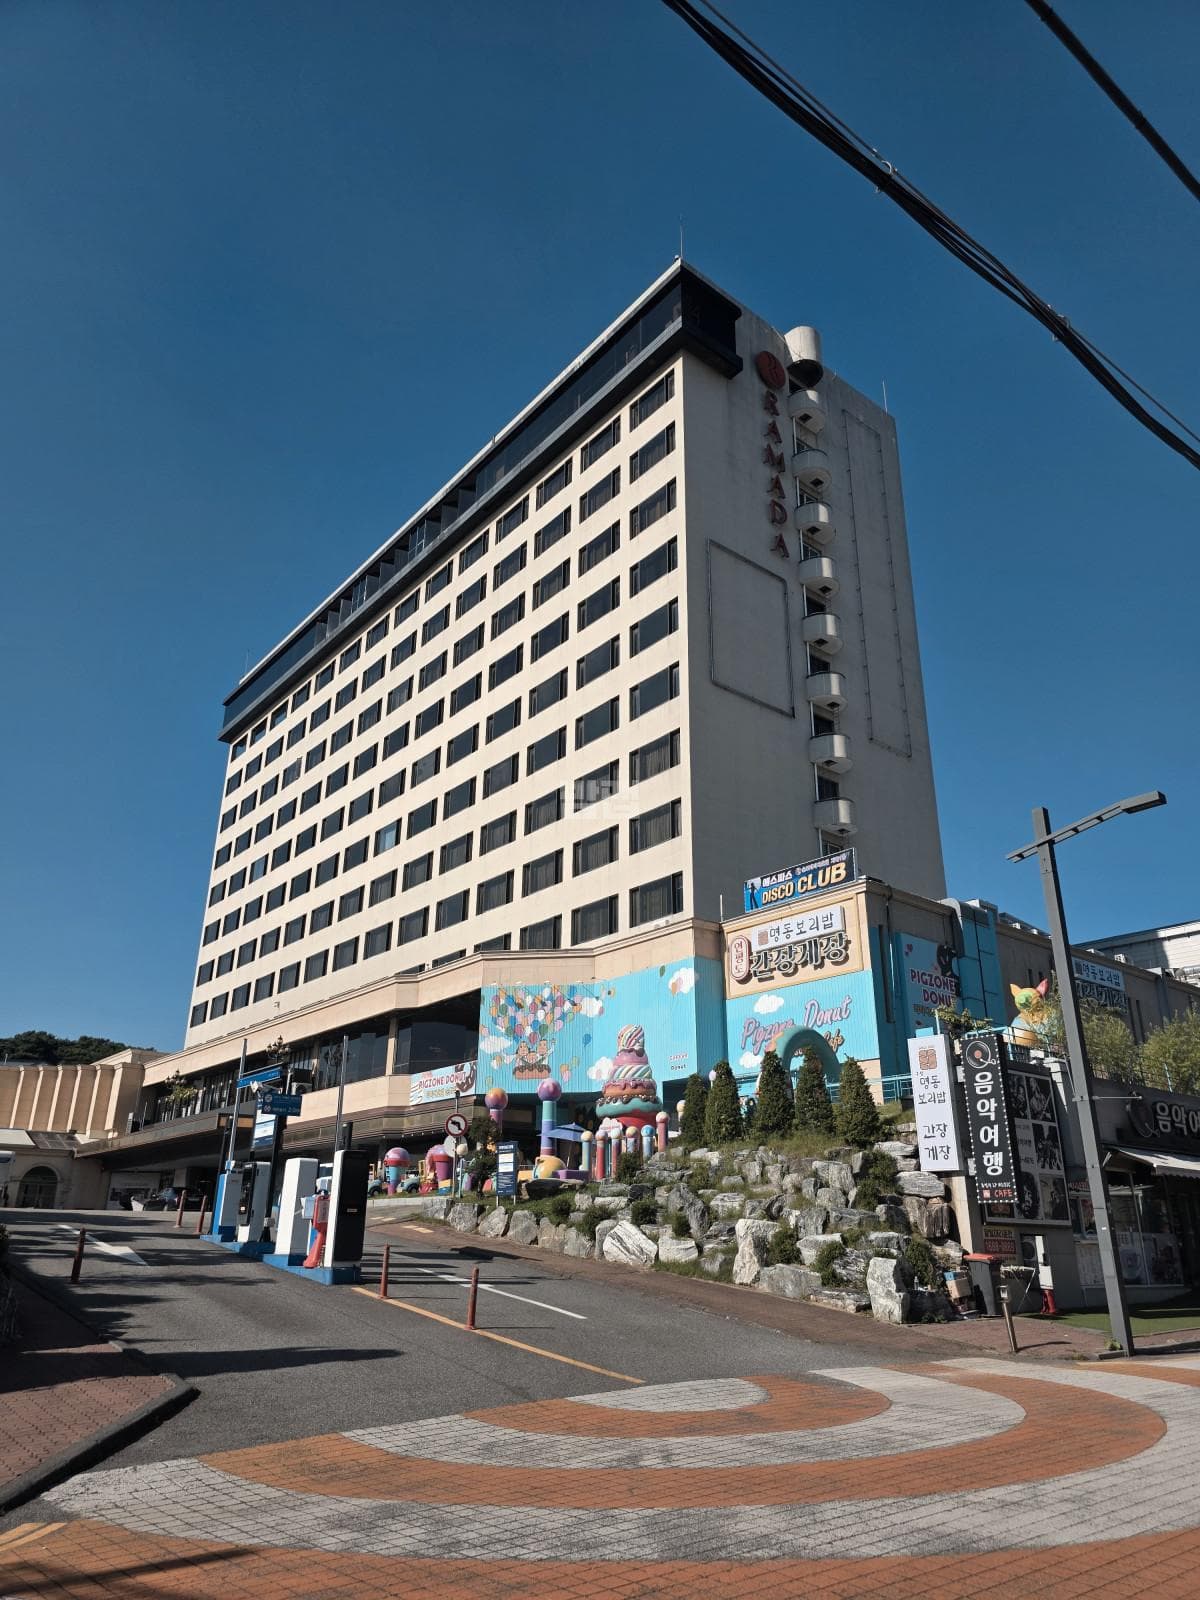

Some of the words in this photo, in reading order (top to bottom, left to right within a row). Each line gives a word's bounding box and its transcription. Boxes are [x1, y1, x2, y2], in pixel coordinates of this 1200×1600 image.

[763, 390, 790, 558] RAMADA
[762, 883, 794, 905] DISCO
[797, 862, 847, 893] CLUB
[769, 912, 834, 943] 명동보리밥
[751, 933, 848, 977] 간장게장
[803, 996, 852, 1028] Donut
[918, 1091, 946, 1104] 보리밥
[922, 1122, 948, 1139] 간장
[974, 1071, 1004, 1176] 음악여행
[924, 1145, 951, 1161] 게장
[994, 1189, 1013, 1198] CAFE
